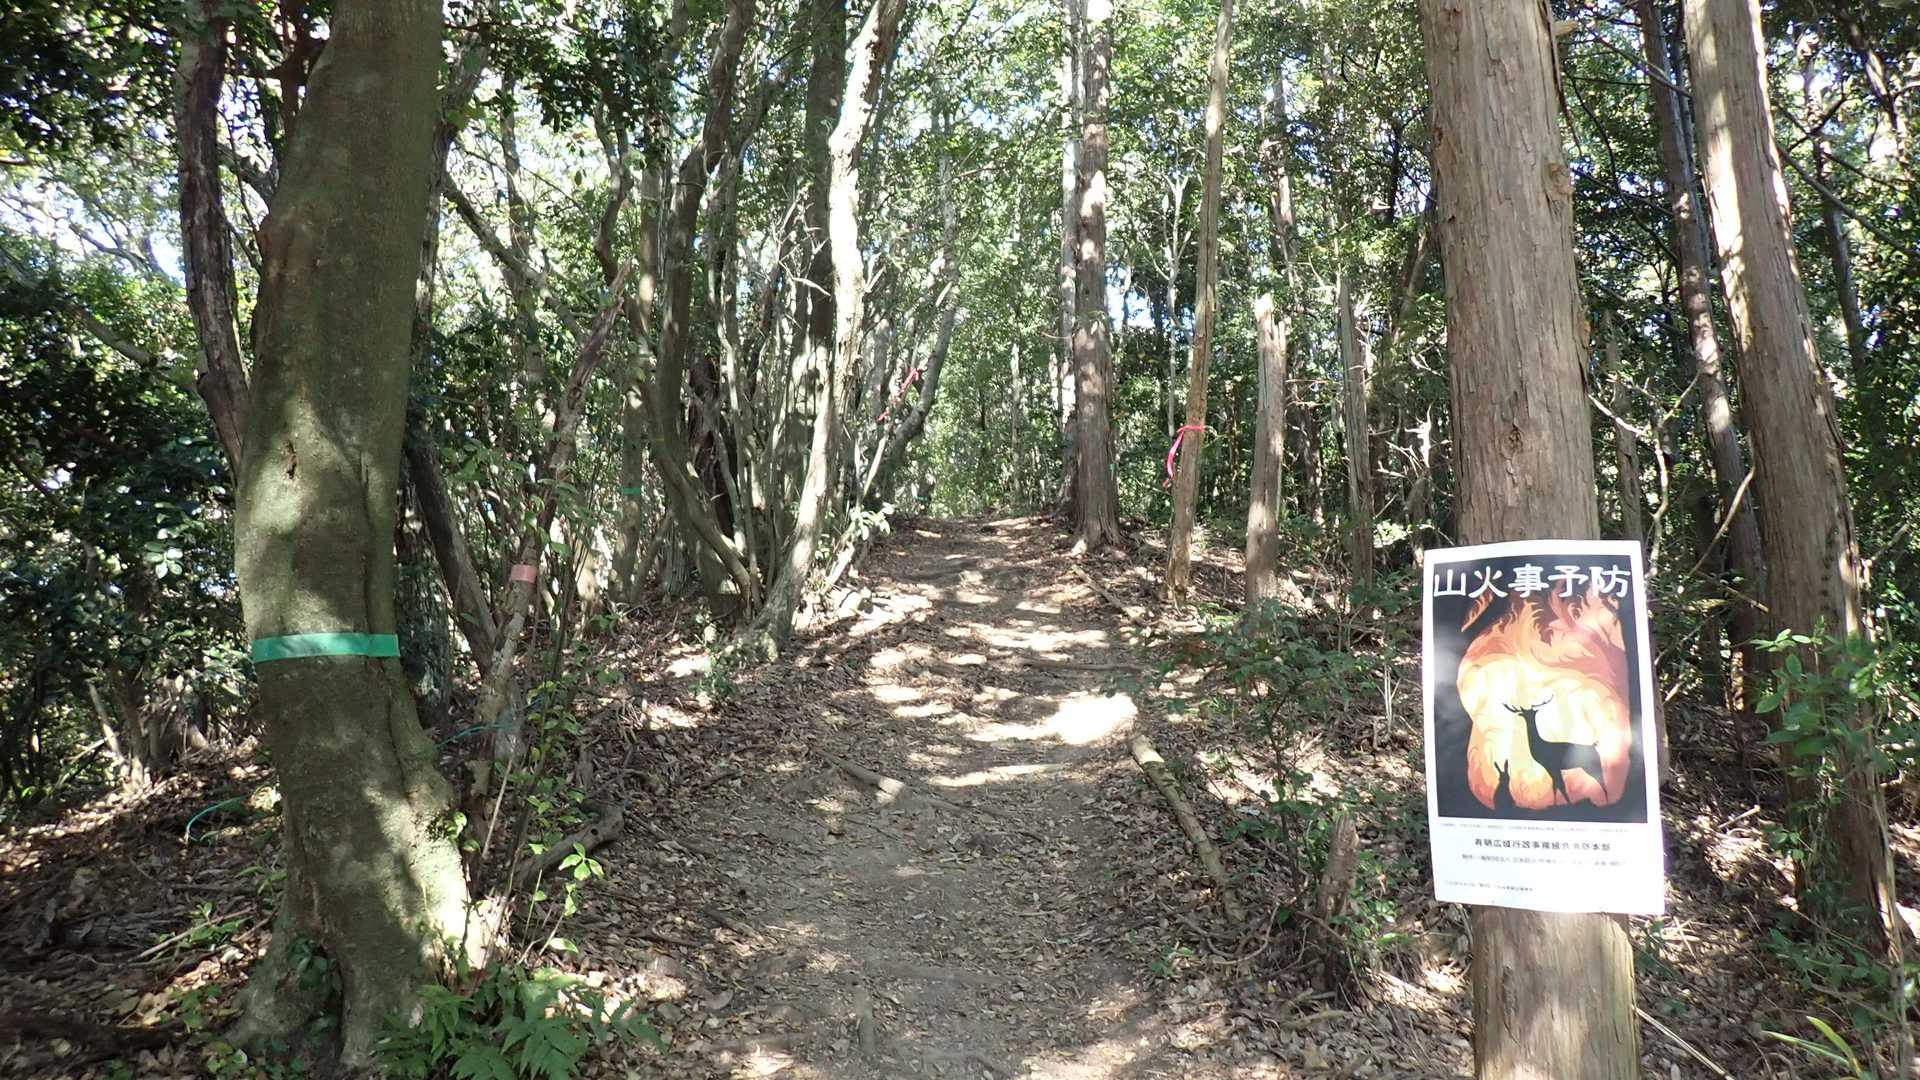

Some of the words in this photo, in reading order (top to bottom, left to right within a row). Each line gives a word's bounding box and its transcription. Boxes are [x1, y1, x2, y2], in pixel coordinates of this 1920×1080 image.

[1433, 563, 1631, 598] 山火事予防
